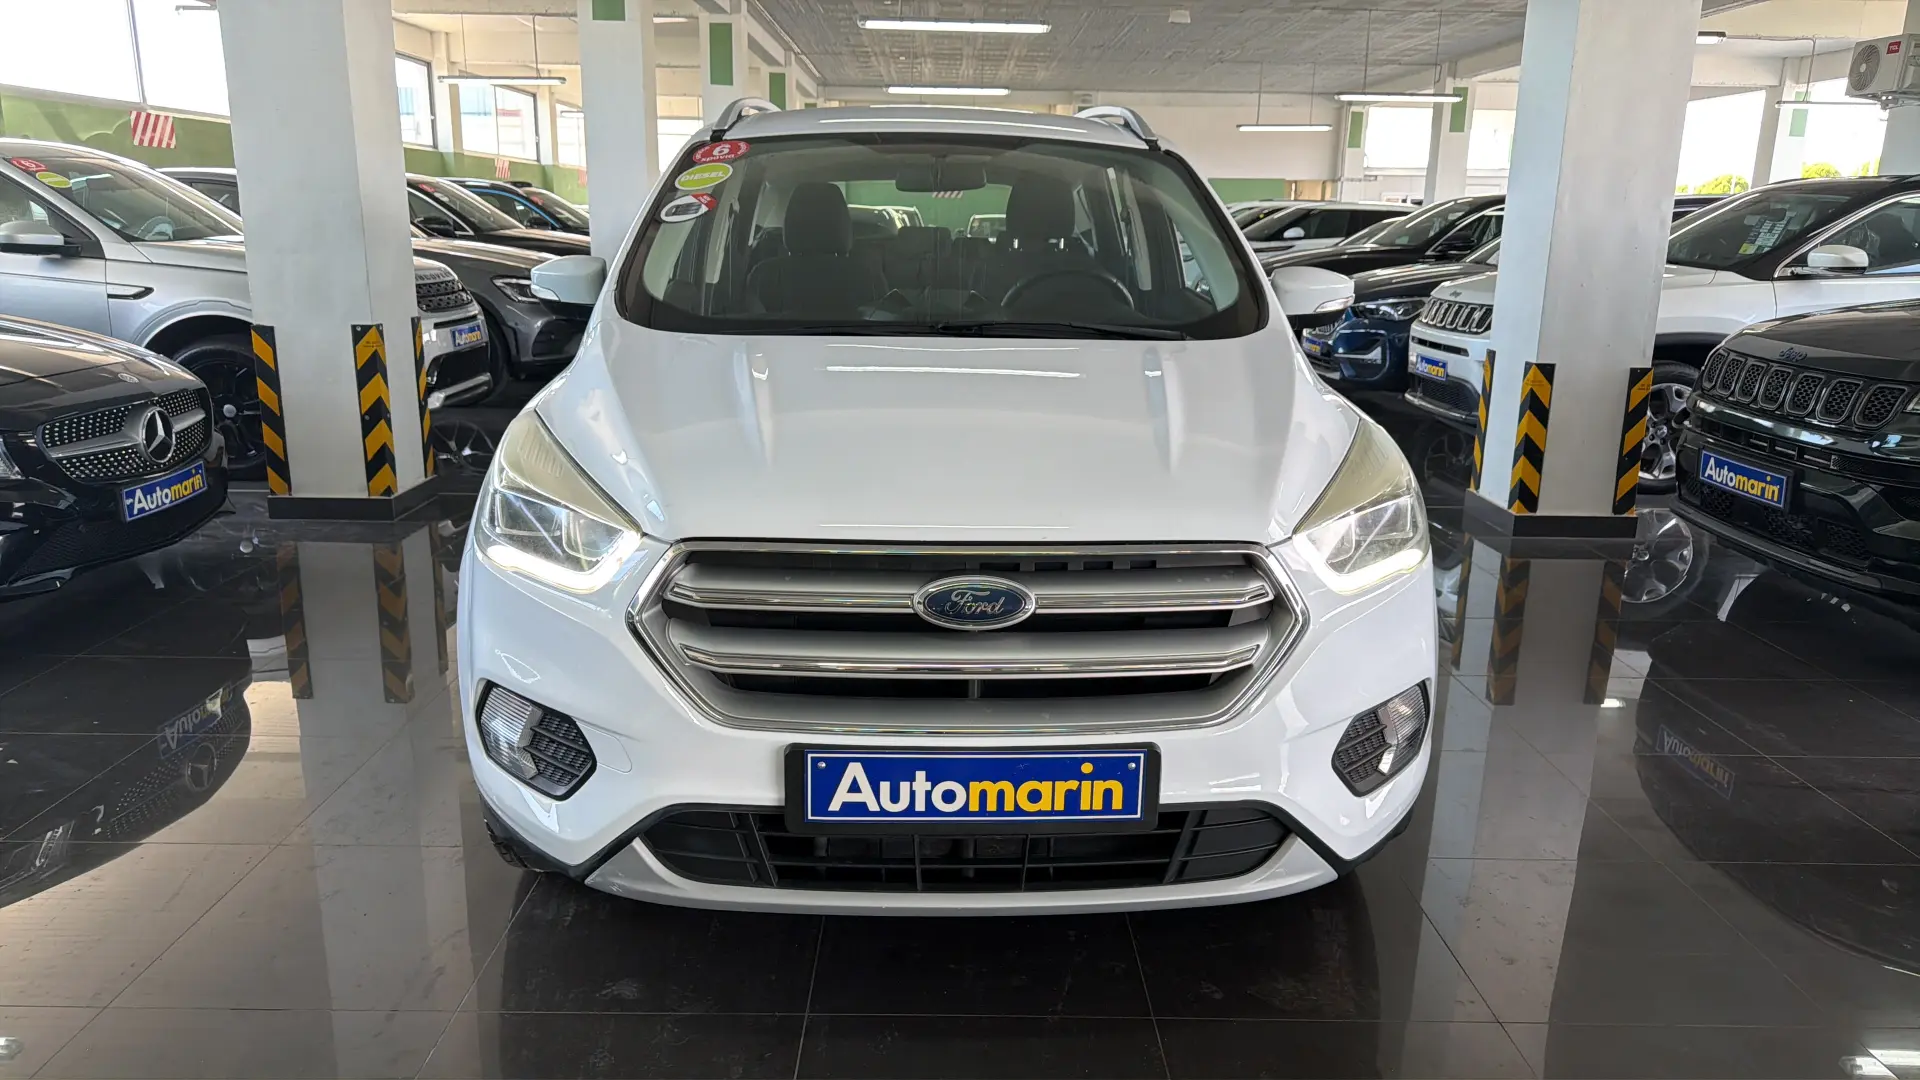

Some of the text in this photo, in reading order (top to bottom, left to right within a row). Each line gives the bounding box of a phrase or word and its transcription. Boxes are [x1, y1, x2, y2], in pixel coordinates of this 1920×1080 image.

[712, 145, 731, 156] 6
[680, 171, 726, 182] DIESEL
[133, 469, 204, 515] Automarin
[1705, 457, 1779, 502] Automarin
[944, 589, 1005, 615] Ford
[828, 762, 1124, 813] Automarin
